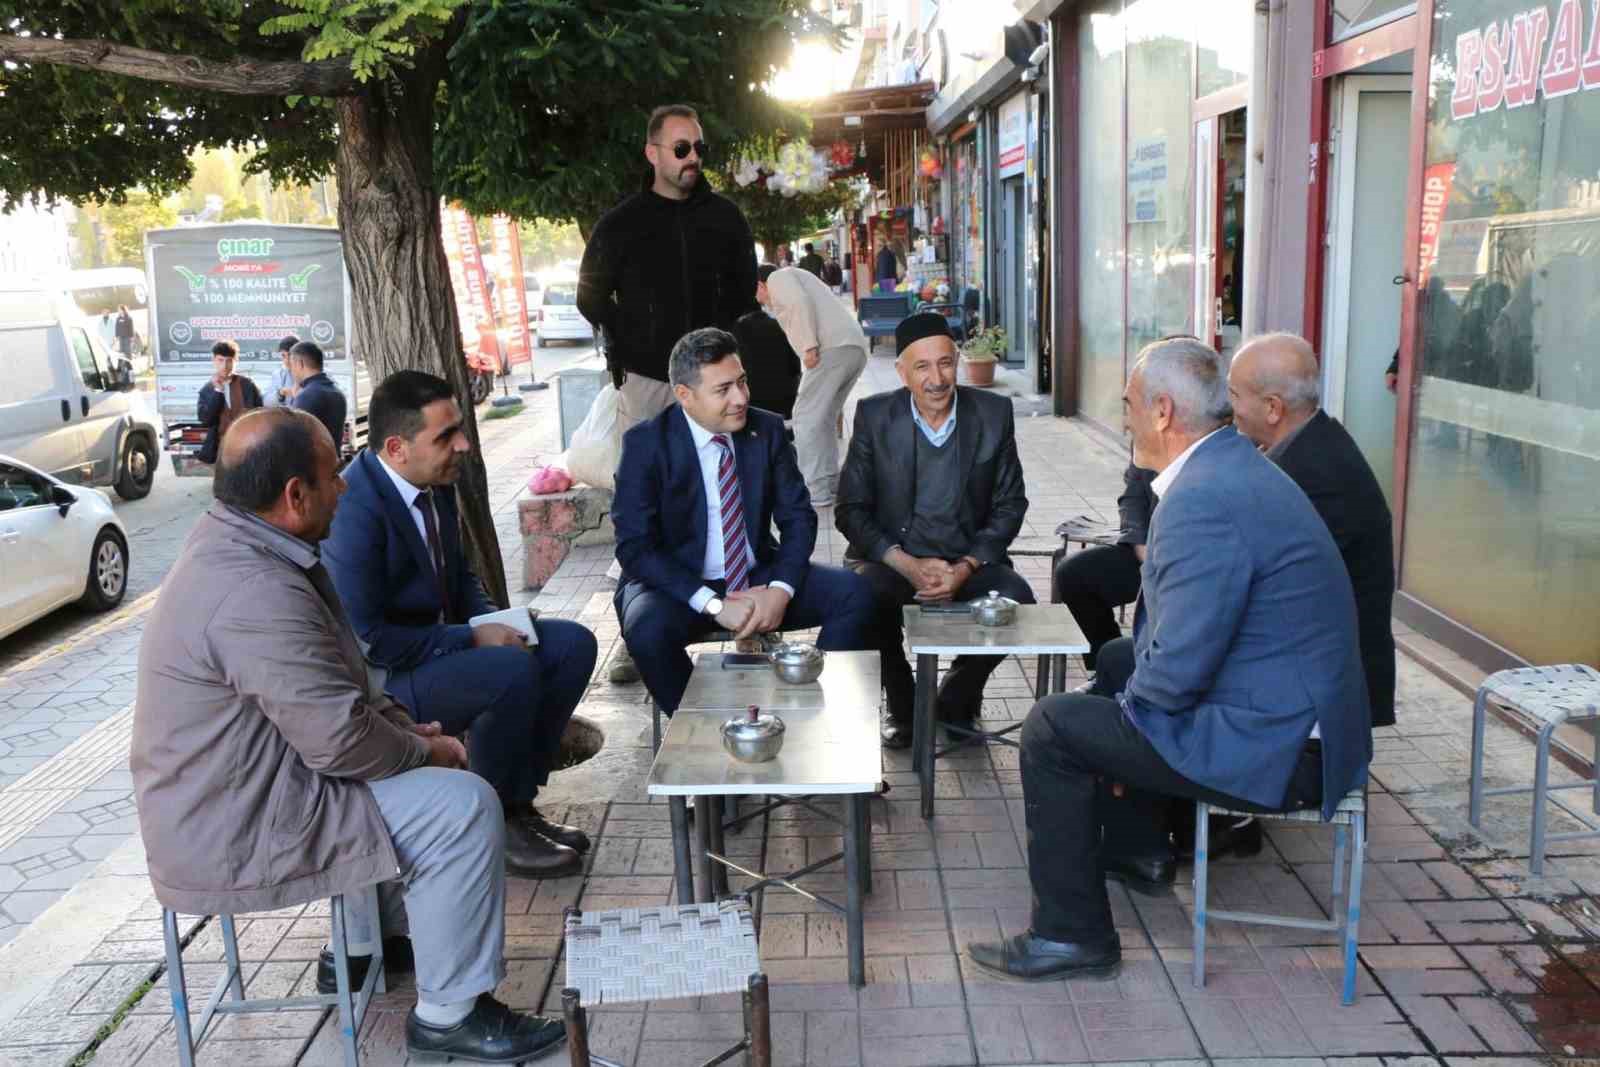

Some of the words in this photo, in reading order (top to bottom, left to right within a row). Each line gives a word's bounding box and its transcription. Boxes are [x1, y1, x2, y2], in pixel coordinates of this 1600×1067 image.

[1421, 177, 1447, 237] SHOP
[217, 238, 274, 262] çınar
[223, 278, 242, 289] 100
[246, 276, 287, 289] KALİTE
[204, 293, 224, 304] 100
